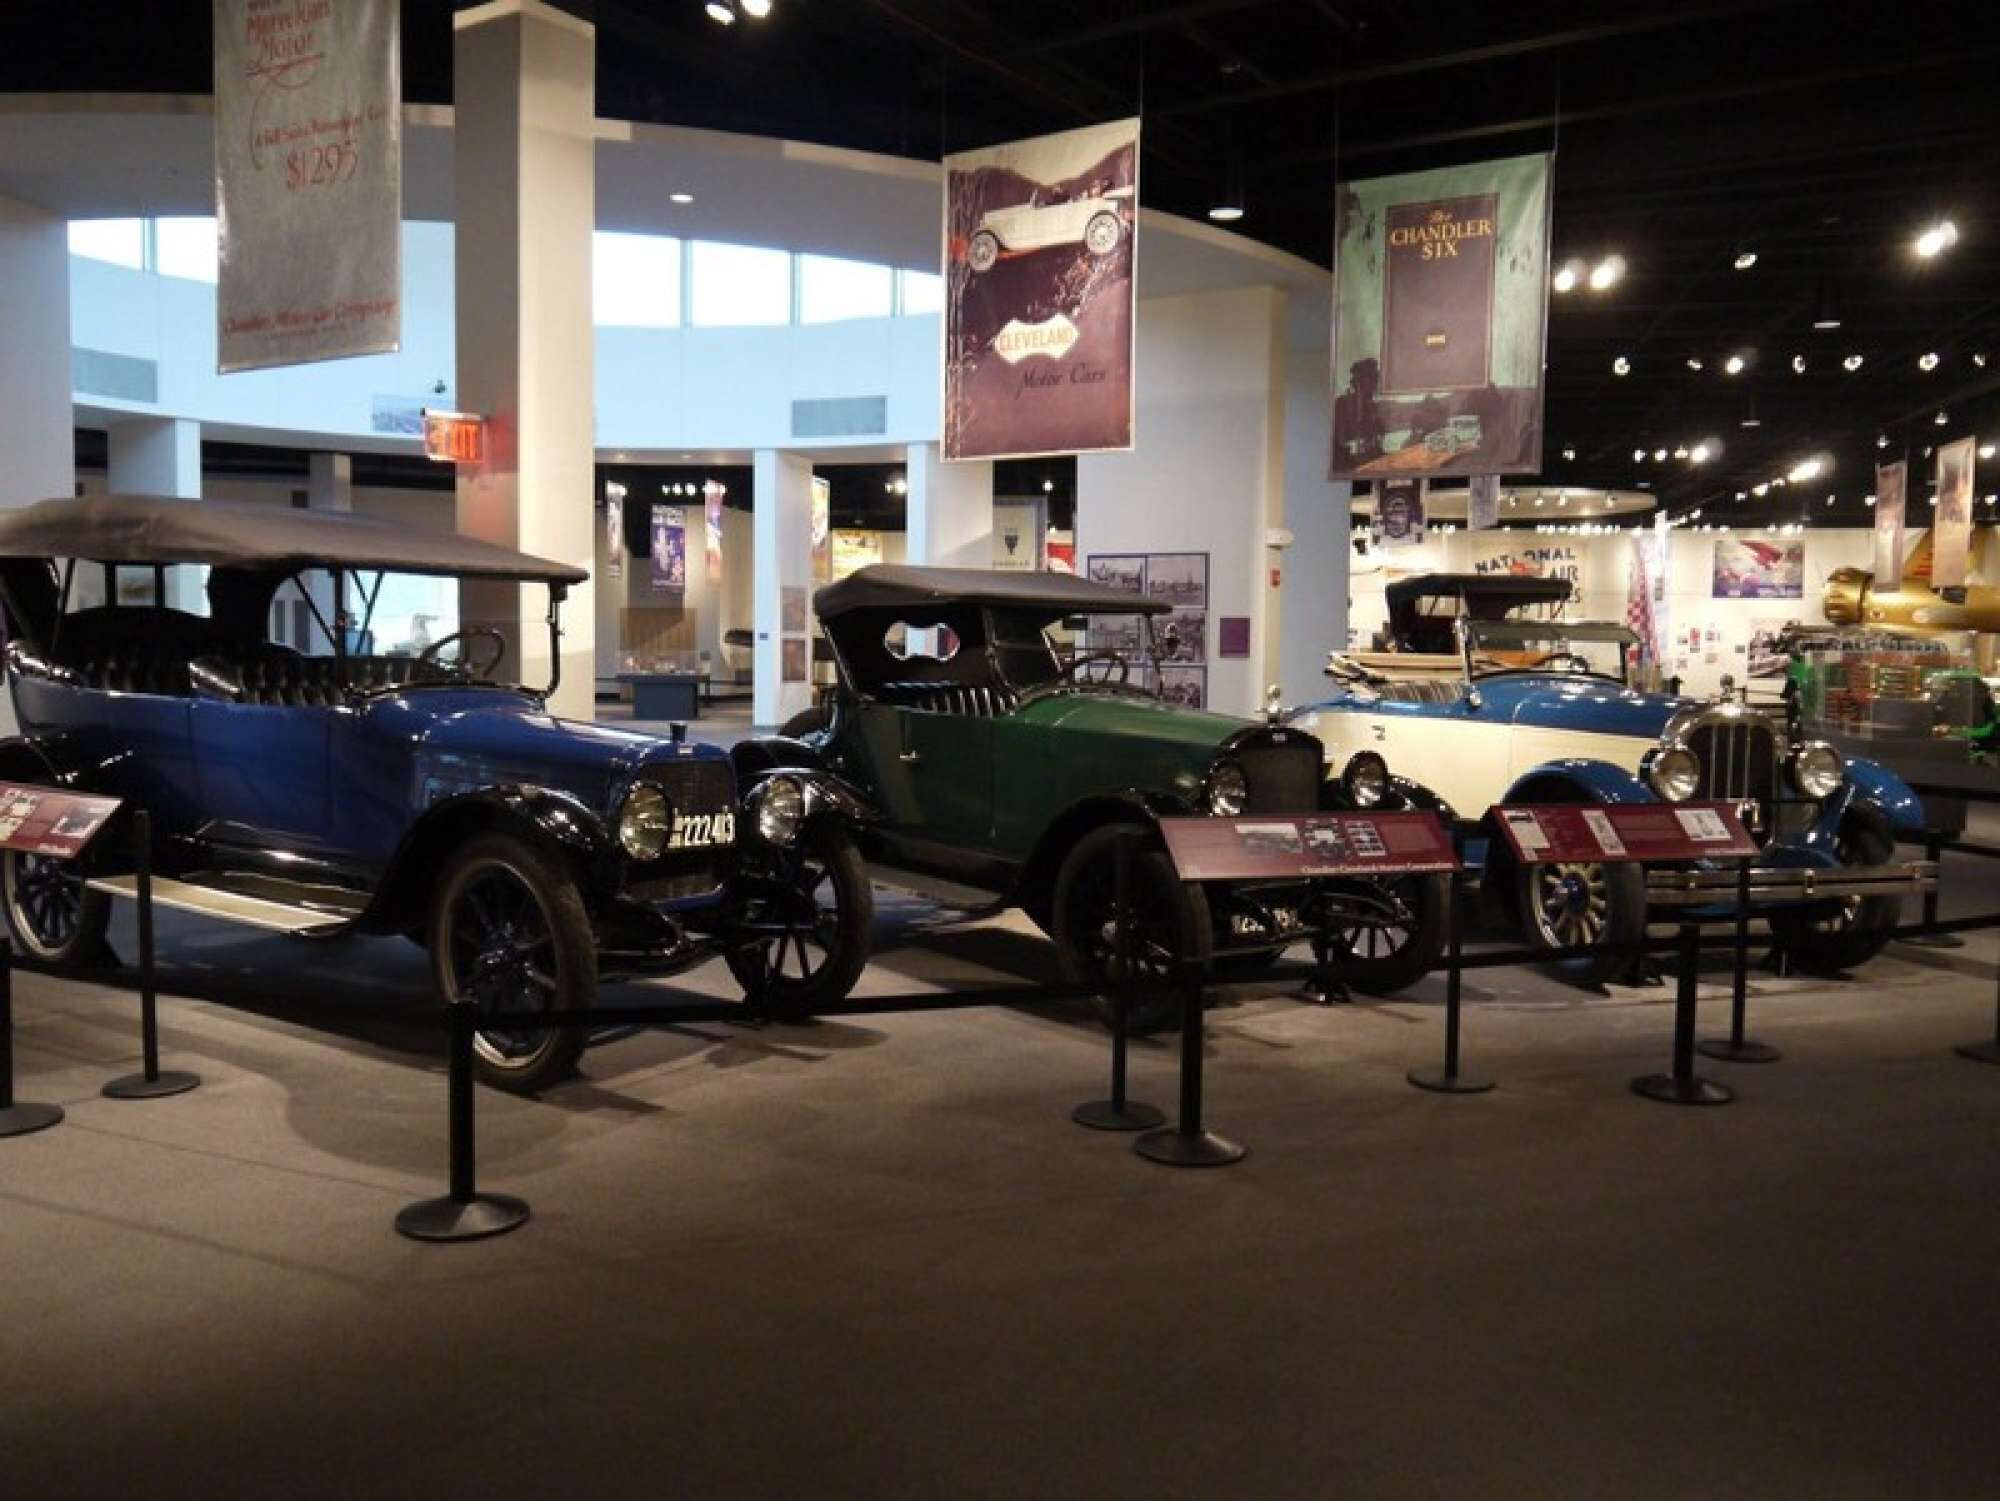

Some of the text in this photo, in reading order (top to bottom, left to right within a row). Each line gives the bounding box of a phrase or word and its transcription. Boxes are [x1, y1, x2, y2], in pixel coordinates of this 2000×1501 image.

[286, 139, 358, 189] $1295
[1390, 218, 1493, 247] CHANDLER
[1421, 239, 1458, 261] SIX
[998, 327, 1074, 352] CLEVELAND
[1015, 362, 1106, 397] Motor Cars
